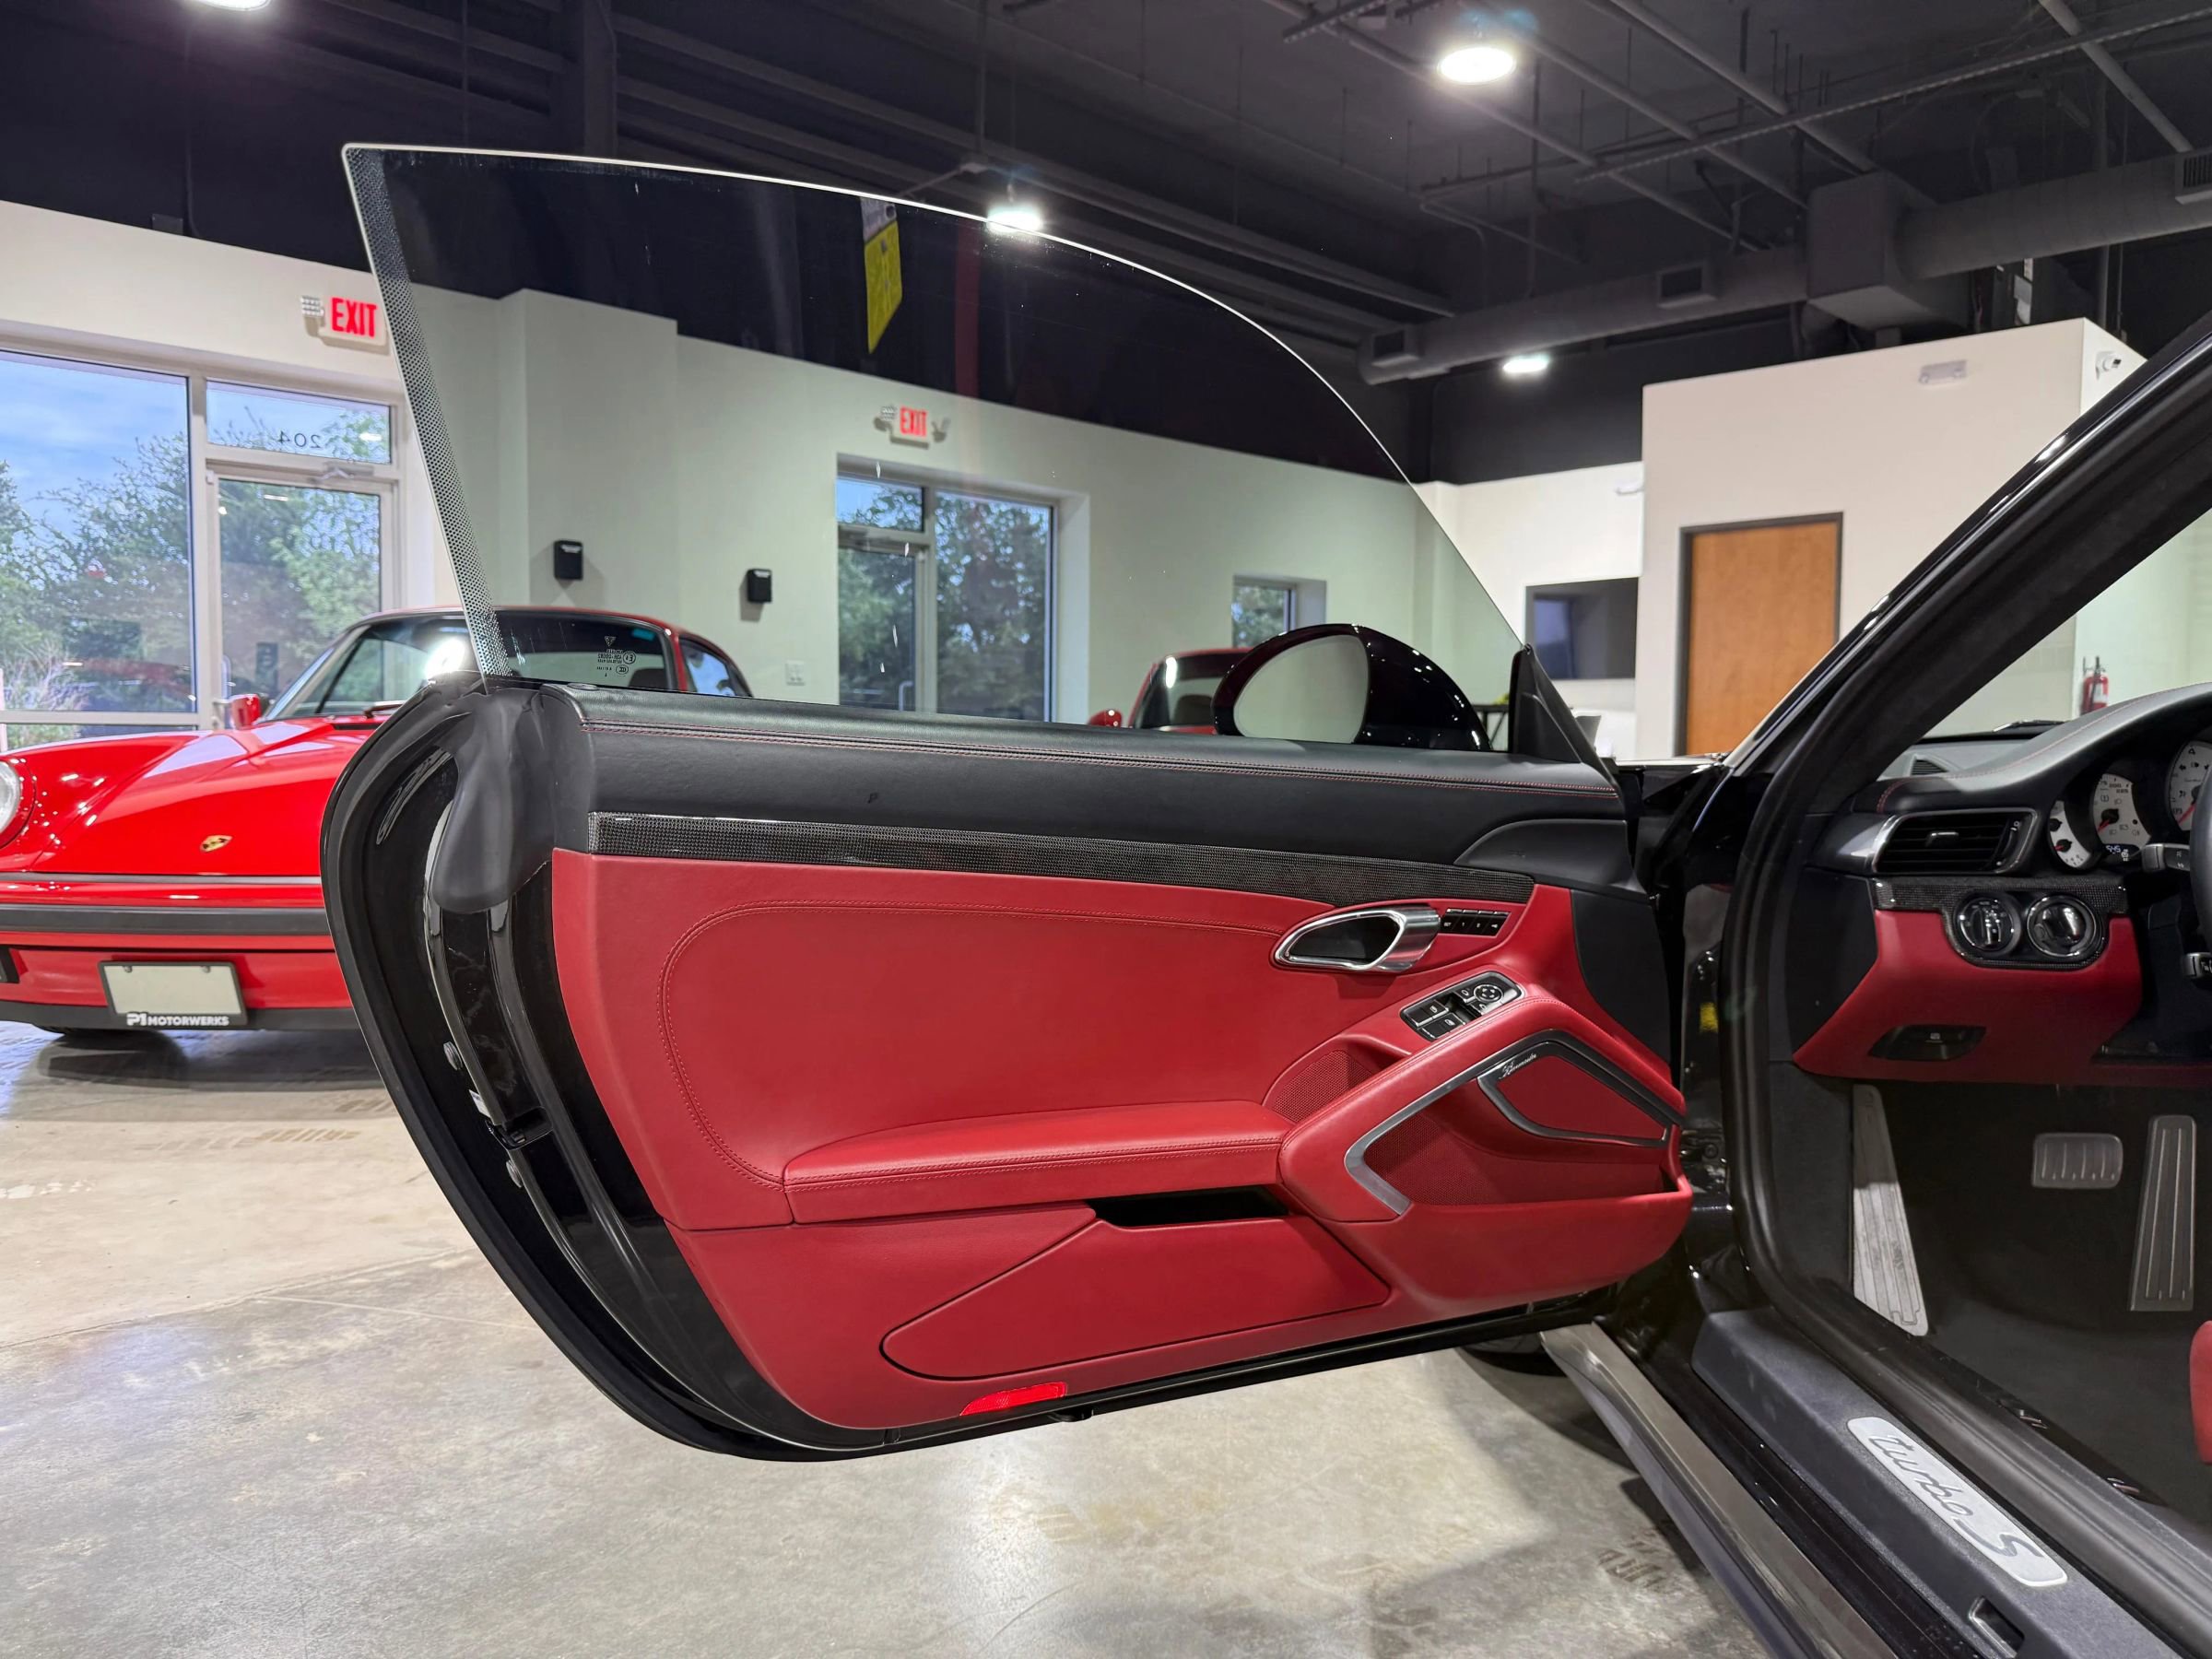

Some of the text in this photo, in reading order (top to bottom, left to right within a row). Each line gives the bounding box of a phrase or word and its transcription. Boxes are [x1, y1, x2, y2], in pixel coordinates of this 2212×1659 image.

[331, 296, 378, 338] EXIT
[900, 406, 927, 438] EXIT
[126, 1013, 229, 1026] P1 MOTORWERKS
[1868, 1434, 2045, 1558] turbo S
